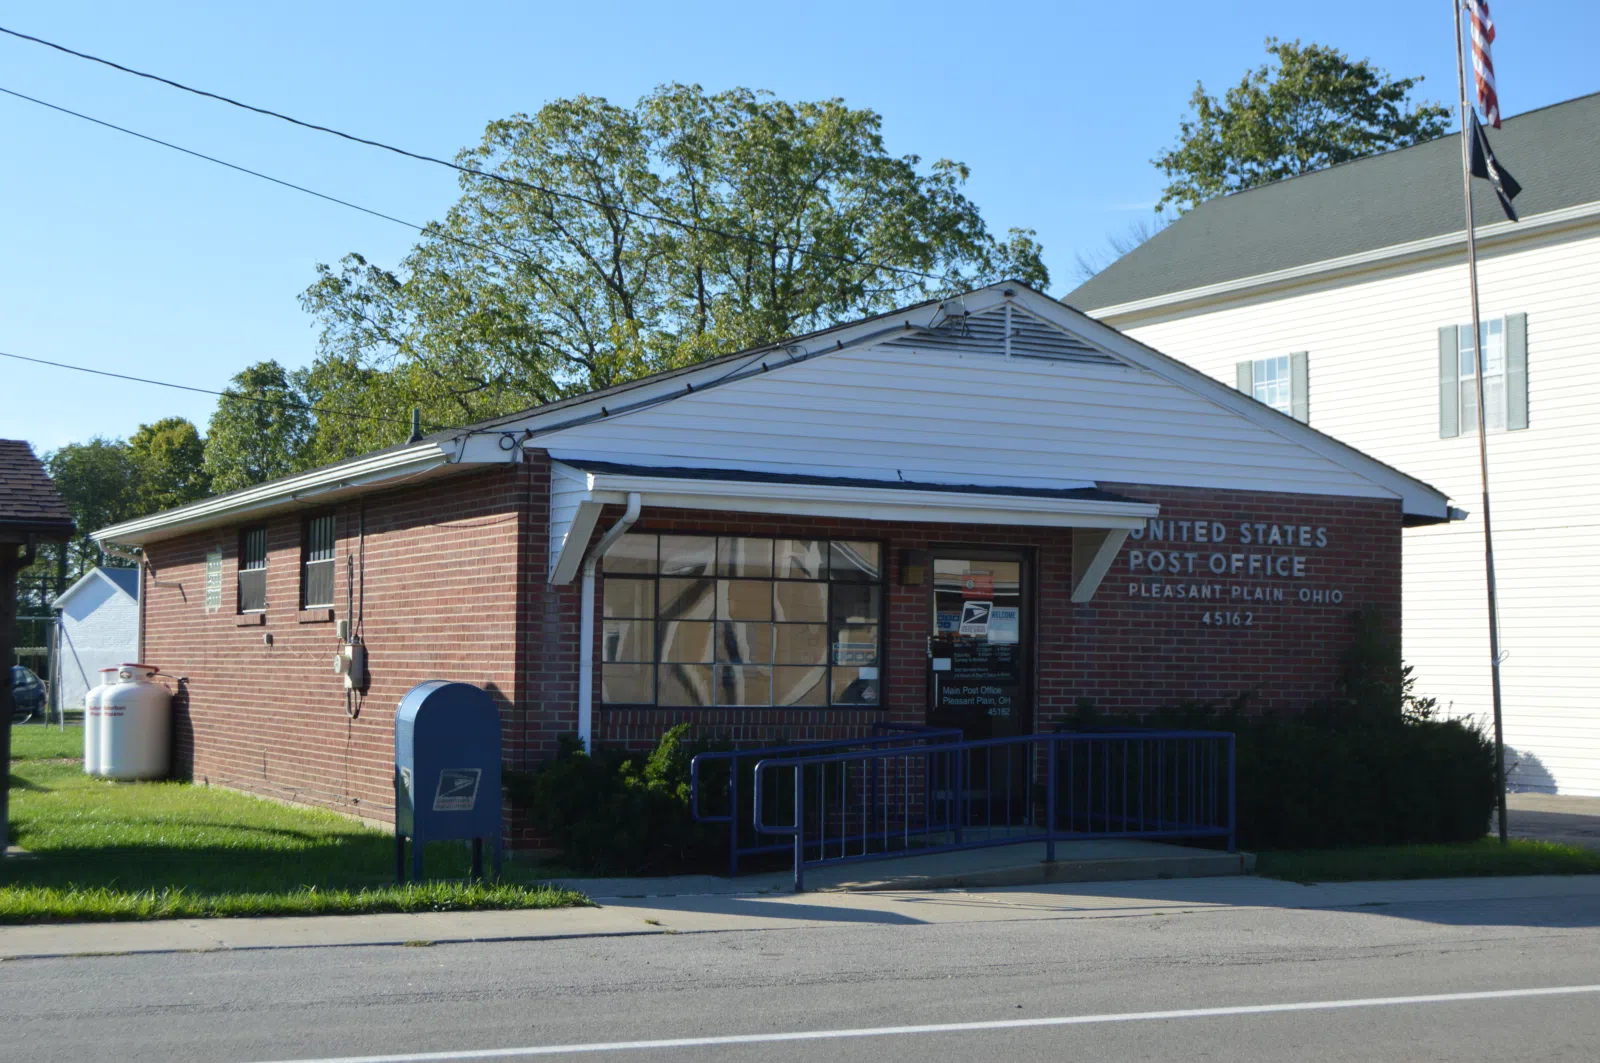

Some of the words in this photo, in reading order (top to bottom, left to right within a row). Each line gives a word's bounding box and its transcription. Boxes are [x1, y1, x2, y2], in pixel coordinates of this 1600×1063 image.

[1130, 520, 1226, 543] UNITED
[1239, 523, 1328, 548] STATES
[1129, 550, 1198, 574] POST
[1209, 553, 1307, 577] OFFICE
[1129, 582, 1222, 600] PLEASANT
[1232, 585, 1283, 601] PLAIN
[1299, 588, 1343, 604] OHIO
[991, 611, 1016, 619] WELCOME
[1202, 611, 1253, 626] 45162
[943, 686, 961, 695] Main
[962, 686, 979, 695] Post
[980, 686, 1002, 695] Office
[943, 696, 975, 705] Pleasant
[998, 696, 1012, 705] OH
[988, 707, 1011, 716] 45162
